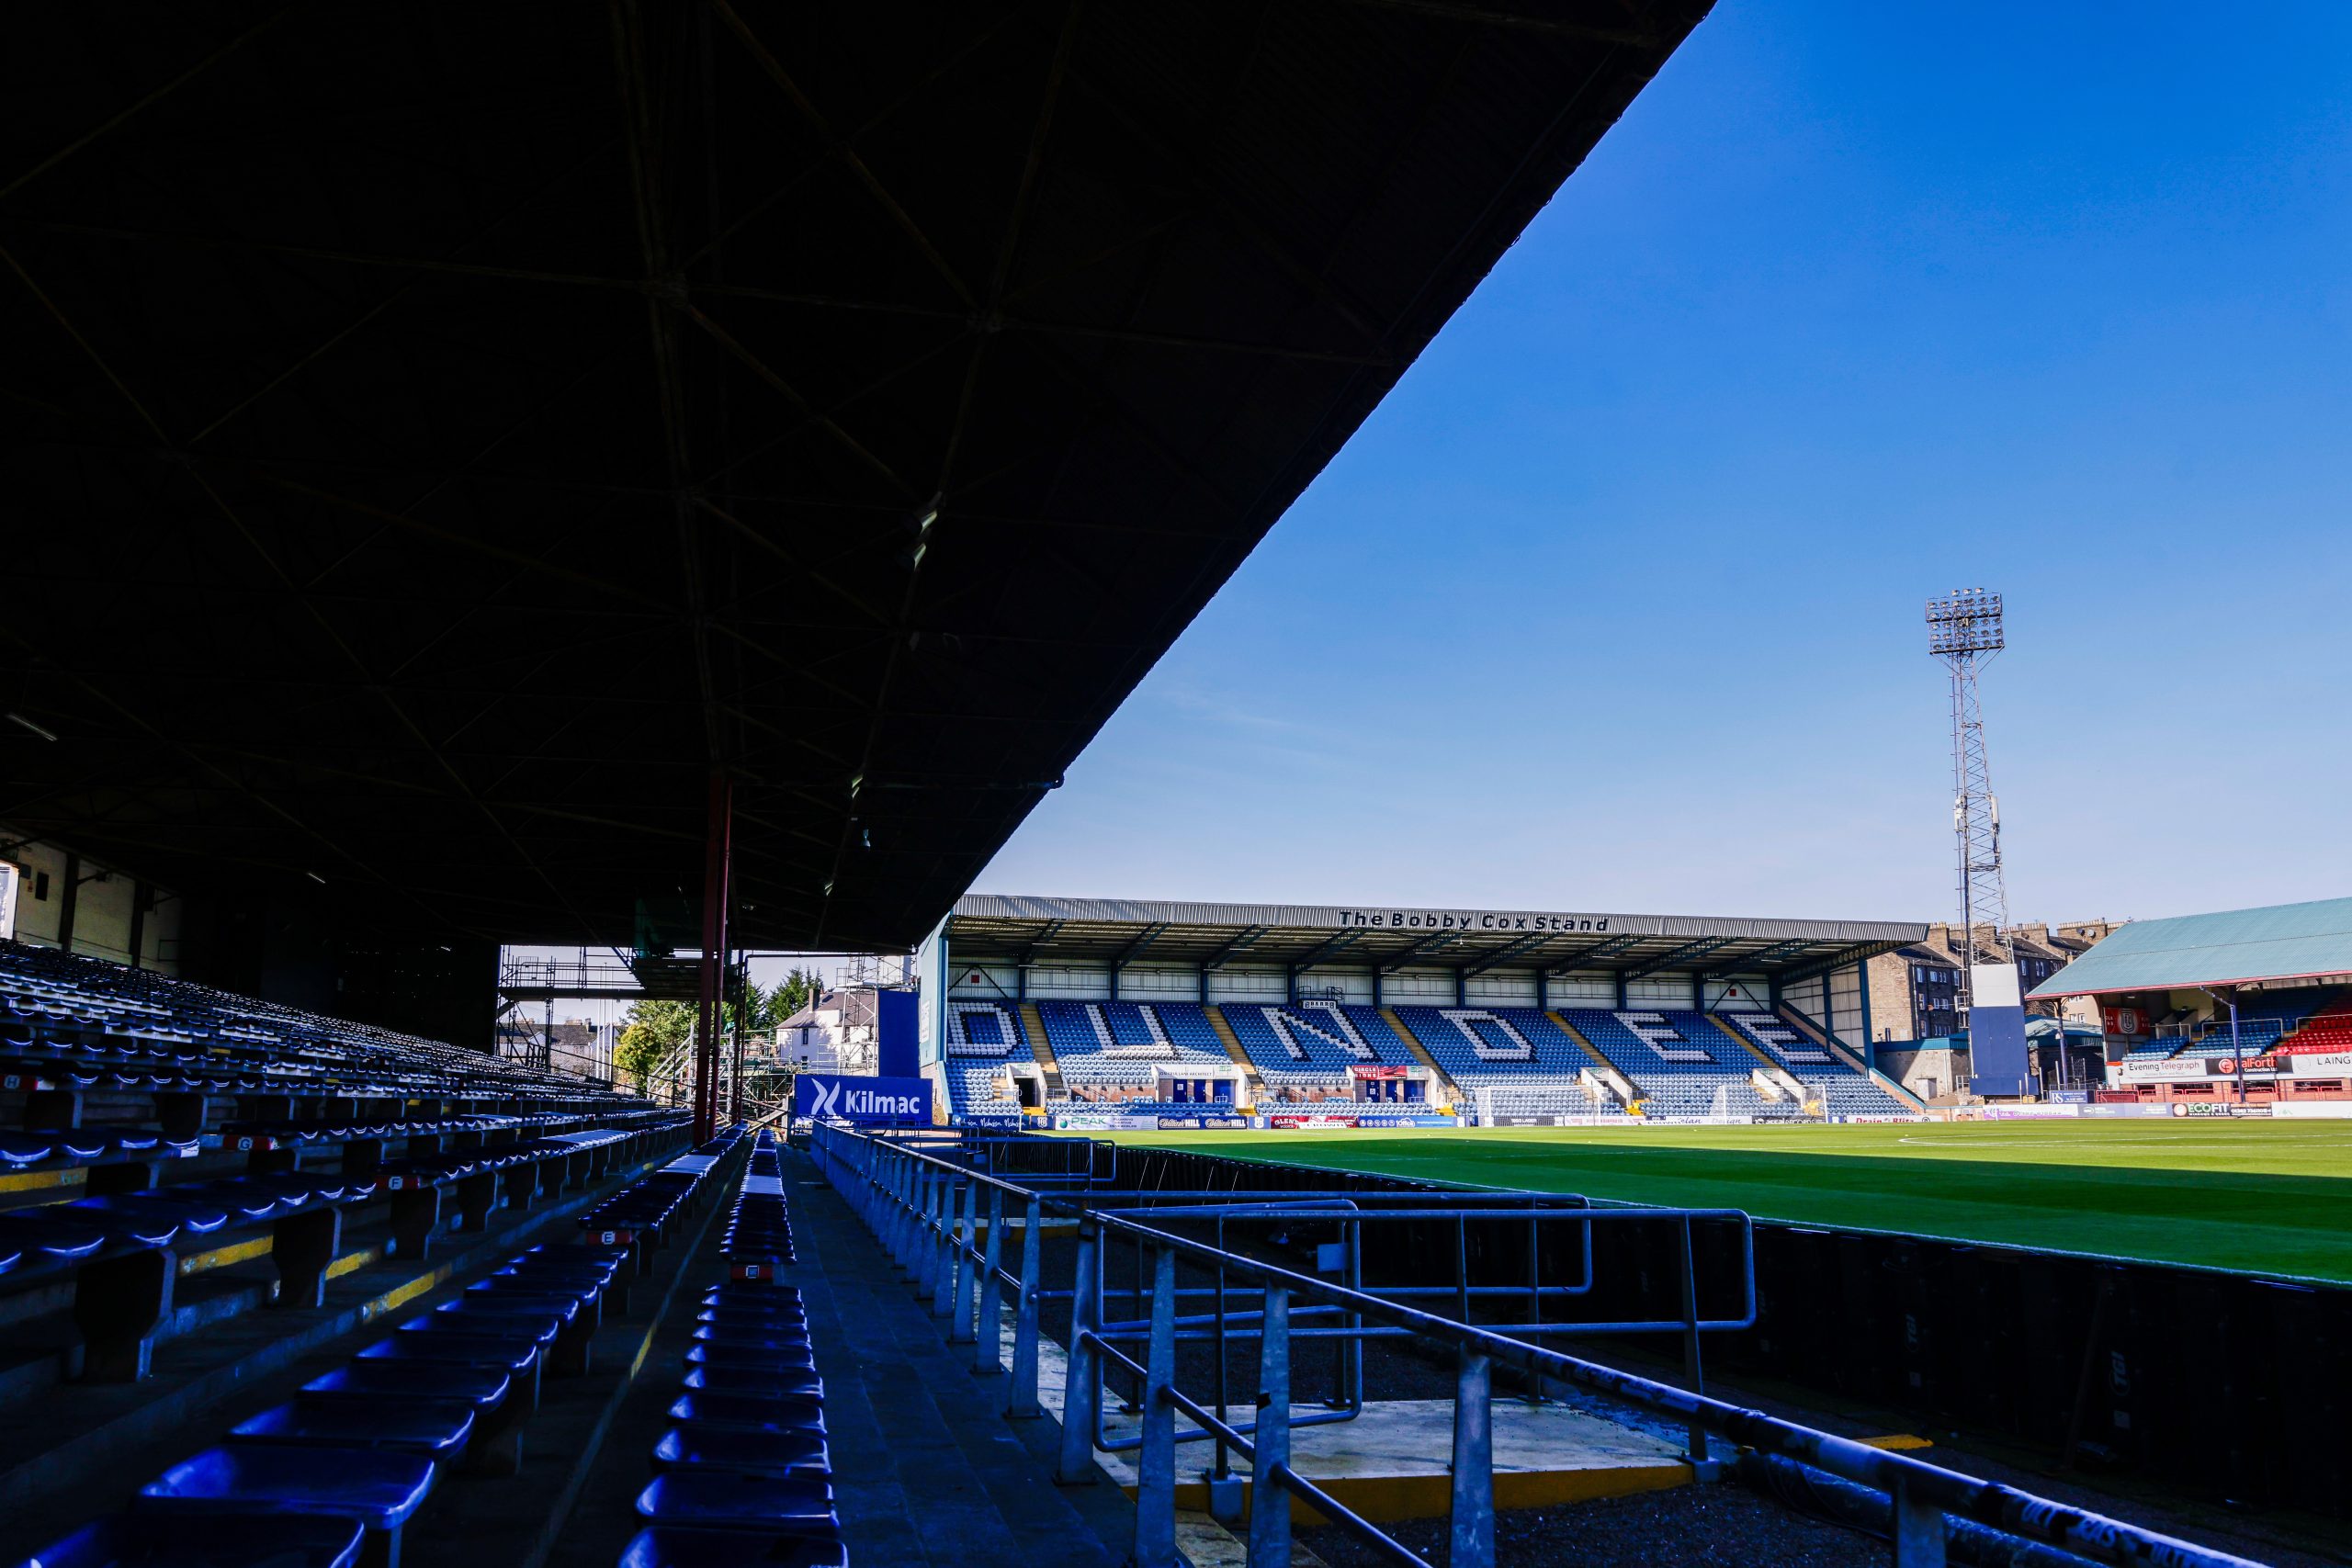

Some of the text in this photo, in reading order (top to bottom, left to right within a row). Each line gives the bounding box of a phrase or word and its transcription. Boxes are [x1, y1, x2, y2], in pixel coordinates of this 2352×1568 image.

[1340, 911, 1608, 931] The Bobby Cox Stand
[2317, 1056, 2351, 1066] LAING
[2129, 1061, 2199, 1073] Evening Telegraph
[845, 1090, 920, 1114] Kilmac
[2188, 1102, 2230, 1113] ECOFIT
[1070, 1117, 1105, 1125] PEAK
[1185, 1119, 1200, 1127] HILL
[1231, 1119, 1246, 1127] HILL
